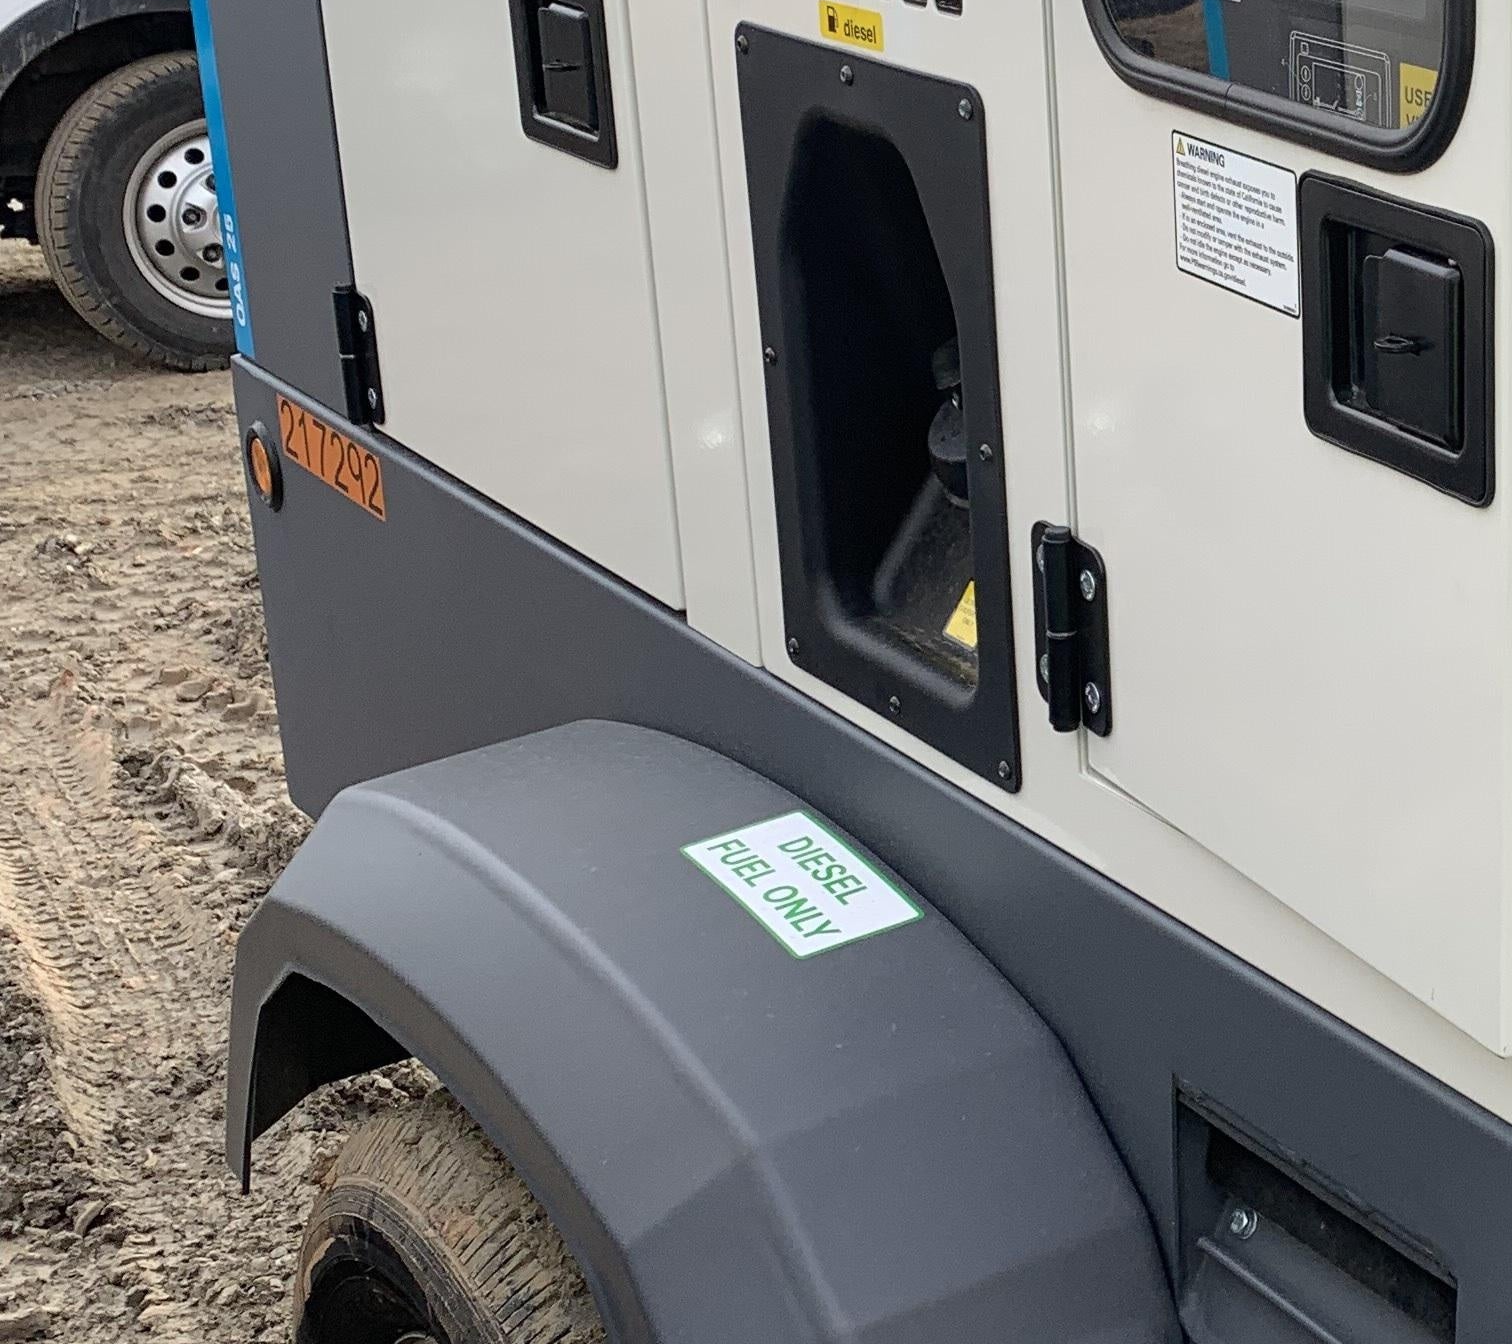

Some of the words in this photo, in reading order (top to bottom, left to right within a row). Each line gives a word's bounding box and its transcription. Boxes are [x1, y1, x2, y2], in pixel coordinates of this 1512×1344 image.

[843, 19, 877, 44] diesel
[1186, 141, 1224, 167] WARNING
[1210, 171, 1223, 183] engine
[1231, 199, 1242, 210] other
[1241, 192, 1262, 207] California
[1206, 200, 1215, 210] and
[1240, 214, 1254, 227] engine
[230, 262, 246, 327] QAS
[280, 399, 383, 515] 217292
[777, 836, 868, 906] DIESEL
[707, 838, 776, 888] FUEL
[762, 884, 842, 939] ONLY
